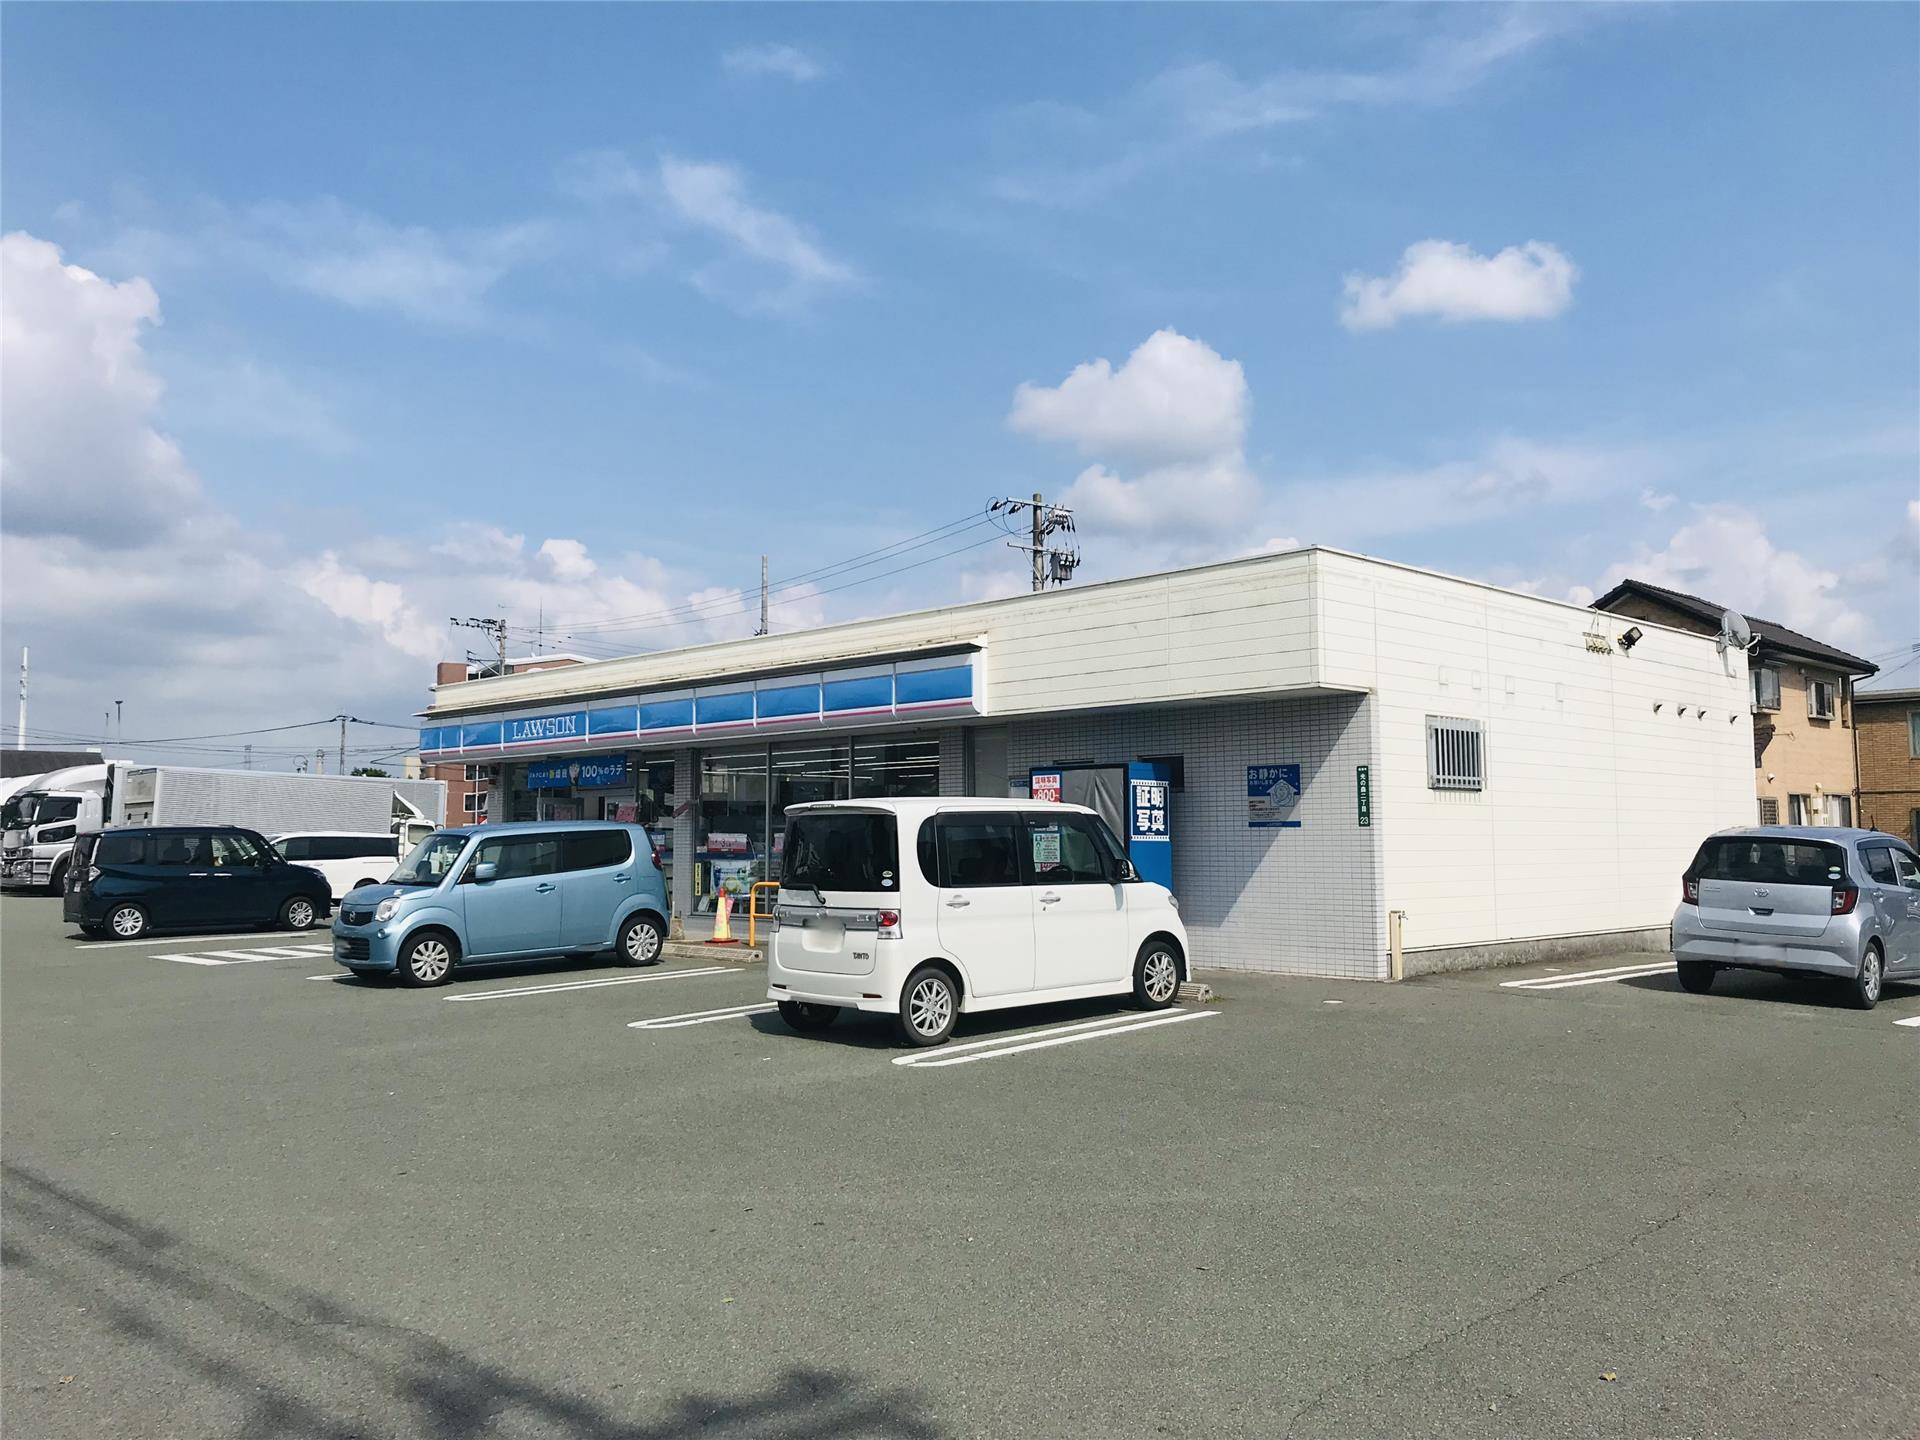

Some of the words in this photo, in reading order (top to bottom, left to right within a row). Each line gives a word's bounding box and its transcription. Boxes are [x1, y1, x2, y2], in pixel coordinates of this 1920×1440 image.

[512, 715, 576, 739] LAWSON
[1249, 768, 1288, 779] お静かに
[1136, 786, 1164, 807] 証明
[1136, 809, 1165, 831] 写真
[1360, 816, 1369, 825] 23
